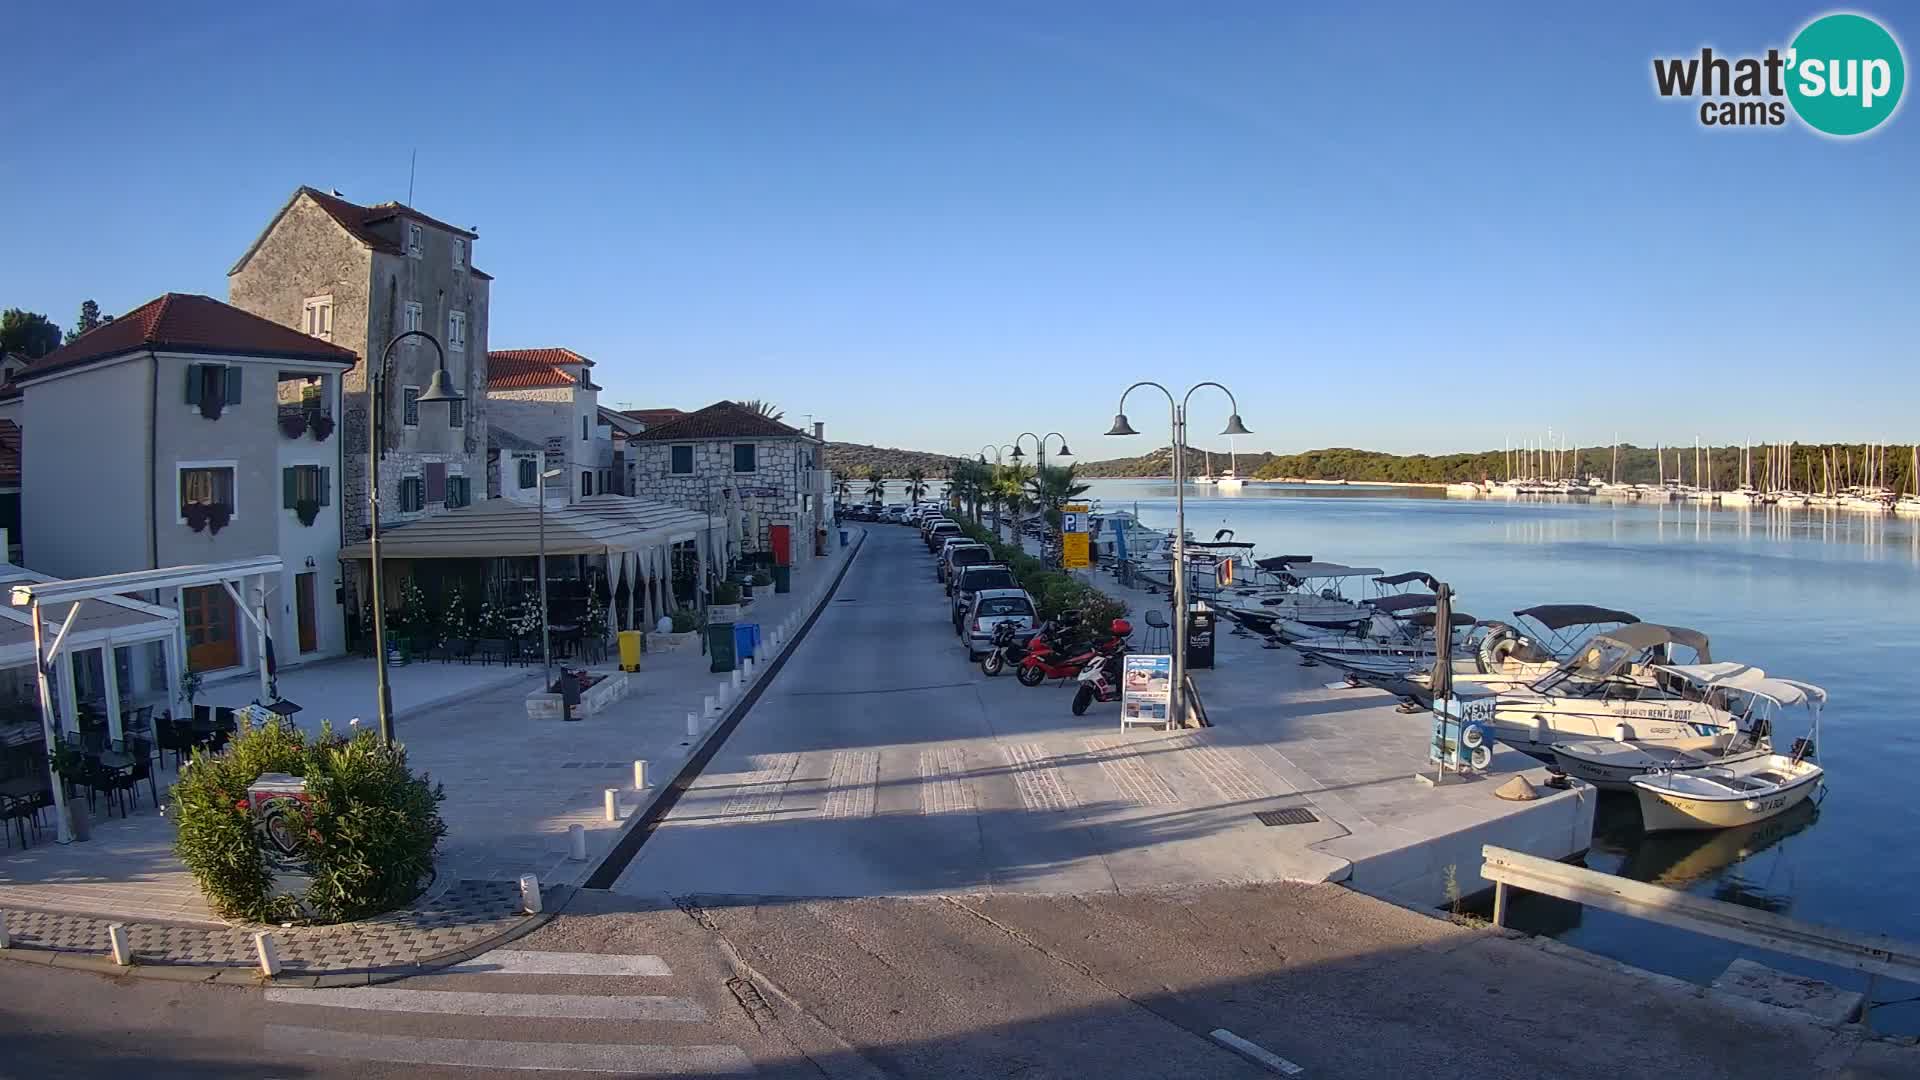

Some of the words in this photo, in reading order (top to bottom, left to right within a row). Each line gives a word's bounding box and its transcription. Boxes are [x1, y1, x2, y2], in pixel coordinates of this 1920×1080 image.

[1463, 702, 1495, 713] RENT
[1471, 711, 1494, 721] BOAT
[1648, 709, 1667, 717] RENT
[1674, 709, 1692, 720] BOAT
